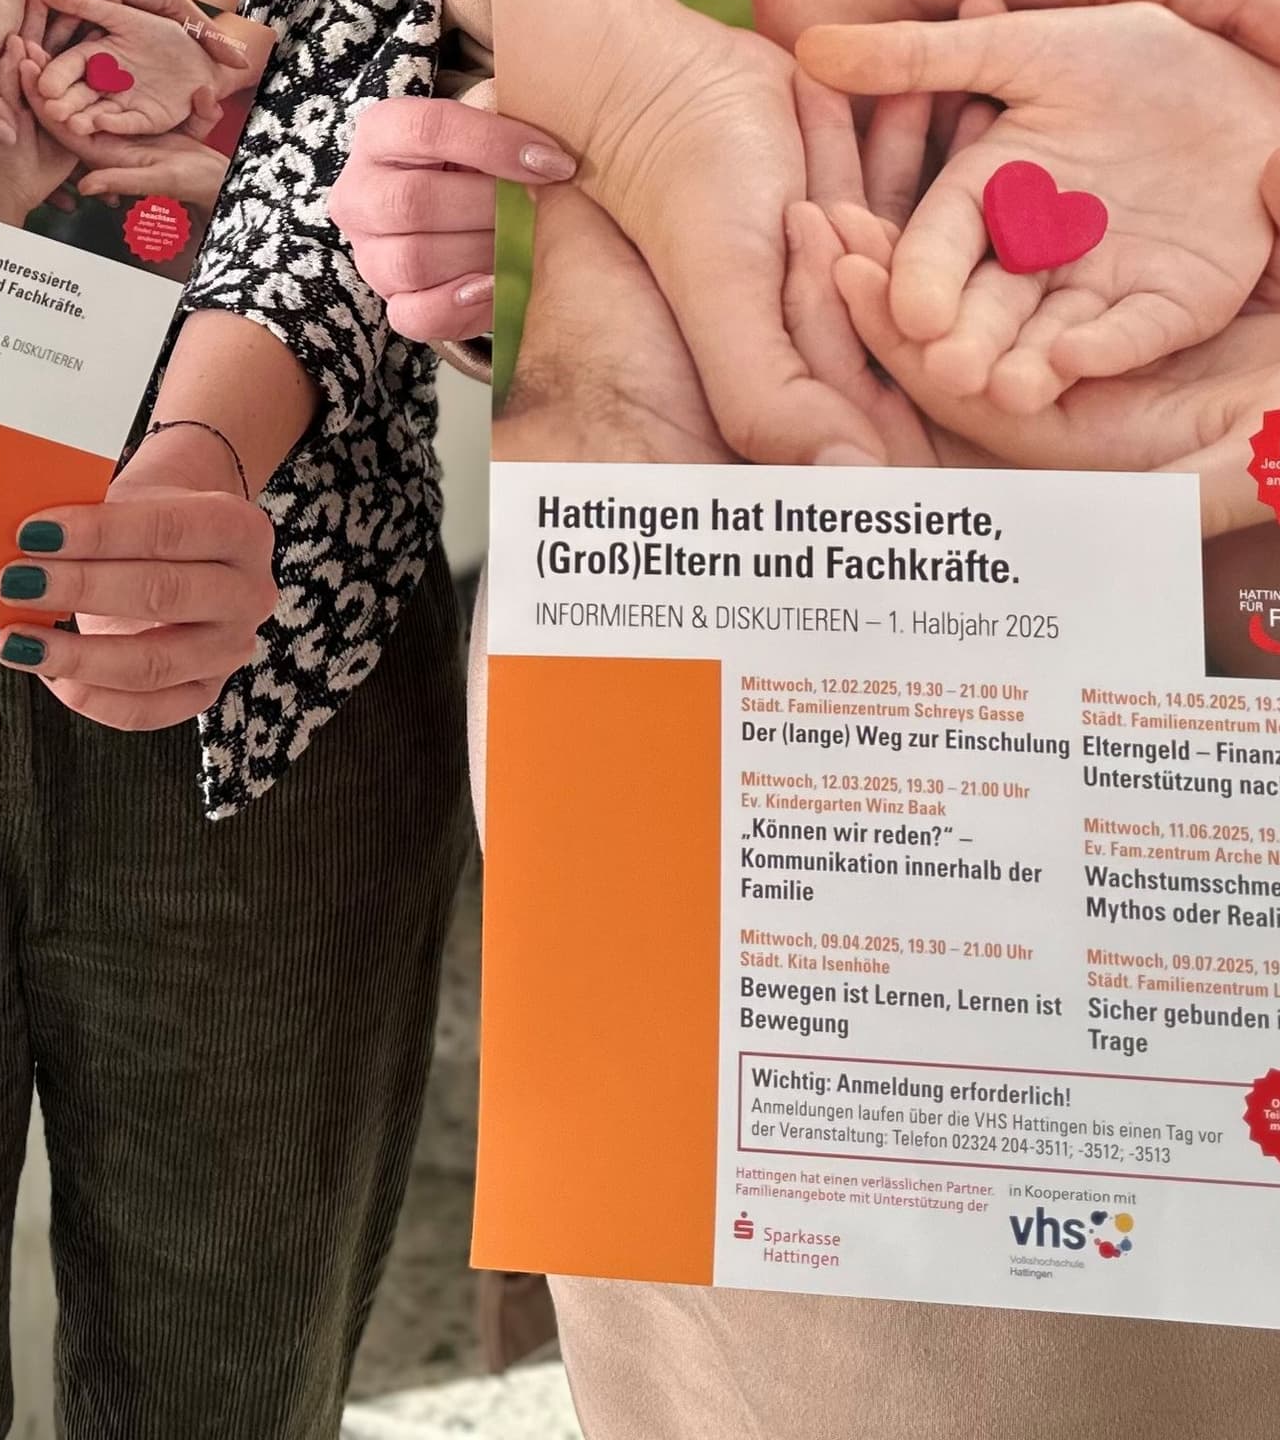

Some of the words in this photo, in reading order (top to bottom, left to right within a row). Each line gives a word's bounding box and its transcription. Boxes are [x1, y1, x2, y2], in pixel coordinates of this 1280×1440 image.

[7, 280, 86, 320] Fachkräfte.
[1, 335, 10, 349] &
[13, 338, 84, 372] DISKUTIEREN
[537, 496, 700, 537] Hattingen
[712, 498, 763, 532] hat
[775, 499, 1003, 541] Interessierte,
[536, 540, 741, 581] (Groß)Eltern
[753, 545, 814, 579] und
[825, 546, 1020, 585] Fachkräfte.
[1239, 599, 1263, 612] FÜR
[536, 603, 684, 628] INFORMIEREN
[692, 606, 709, 629] &
[715, 606, 859, 633] DISKUTIEREN
[888, 611, 904, 633] 1.
[912, 612, 999, 641] Halbjahr
[1006, 614, 1059, 640] 2025
[741, 676, 817, 695] Mittwoch,
[822, 679, 901, 697] 12.02.2025,
[907, 681, 943, 697] 19.30
[959, 683, 998, 699] 21.00
[1002, 684, 1029, 701] Uhr
[1081, 688, 1161, 708] Mittwoch,
[1165, 692, 1250, 711] 14.05.2025,
[741, 697, 783, 713] Städt.
[788, 698, 910, 717] Familienzentrum
[914, 703, 974, 722] Schreys
[978, 705, 1025, 722] Gasse
[1081, 710, 1123, 728] Städt.
[1131, 712, 1260, 734] Familienzentrum
[742, 721, 776, 742] Der
[782, 722, 850, 748] (lange)
[856, 725, 902, 750] Weg
[908, 732, 939, 748] zur
[945, 728, 1070, 759] Einschulung
[1083, 736, 1190, 763] Elterngeld
[1083, 765, 1233, 798] Unterstützung
[742, 817, 827, 841] „Können
[833, 824, 868, 842] wir
[741, 847, 898, 875] Kommunikation
[905, 855, 1002, 881] innerhalb
[1008, 861, 1042, 883] der
[1084, 840, 1106, 856] Ev.
[1111, 841, 1210, 862] Fam.zentrum
[1215, 847, 1262, 865] Arche
[741, 878, 814, 901] Familie
[1086, 896, 1166, 924] Mythos
[1172, 902, 1220, 925] oder
[740, 951, 783, 968] Städt.
[788, 953, 817, 970] Kita
[822, 956, 890, 974] Isenhöhe
[740, 977, 837, 1005] Bewegen
[843, 982, 868, 1004] ist
[875, 984, 951, 1011] Lernen,
[958, 989, 1029, 1014] Lernen
[1036, 993, 1062, 1016] ist
[1087, 971, 1132, 989] Städt.
[1137, 975, 1269, 998] Familienzentrum
[740, 1007, 849, 1039] Bewegung
[1088, 997, 1158, 1022] Sicher
[1164, 1004, 1270, 1029] gebunden
[1087, 1028, 1148, 1056] Trage
[752, 1068, 832, 1095] Wichtig:
[836, 1073, 943, 1103] Anmeldung
[950, 1082, 1071, 1107] erforderlich!
[751, 1097, 853, 1122] Anmeldungen
[858, 1104, 904, 1122] laufen
[910, 1109, 943, 1125] über
[947, 1110, 969, 1127] die
[975, 1112, 1007, 1129] VHS
[1013, 1114, 1087, 1137] Hattingen
[1092, 1121, 1114, 1136] bis
[1119, 1122, 1161, 1139] einen
[1166, 1124, 1193, 1145] Tag
[1198, 1130, 1223, 1143] vor
[751, 1121, 776, 1137] der
[780, 1122, 888, 1148] Veranstaltung:
[893, 1130, 948, 1148] Telefon
[952, 1134, 997, 1152] 02324
[1001, 1136, 1073, 1159] 204-3511;
[1078, 1142, 1124, 1162] -3512;
[1128, 1146, 1171, 1163] -3513
[736, 1167, 797, 1184] Hattingen
[801, 1171, 820, 1185] hat
[824, 1174, 858, 1187] einen
[861, 1176, 942, 1193] verlässlichen
[946, 1181, 995, 1197] Partner.
[1009, 1184, 1021, 1197] in
[1025, 1185, 1111, 1203] Kooperation
[1113, 1192, 1136, 1205] mit
[763, 1228, 841, 1247] Sparkasse
[1009, 1206, 1086, 1250] vhs
[763, 1248, 839, 1269] Hattingen
[1010, 1267, 1052, 1279] Hattingen
